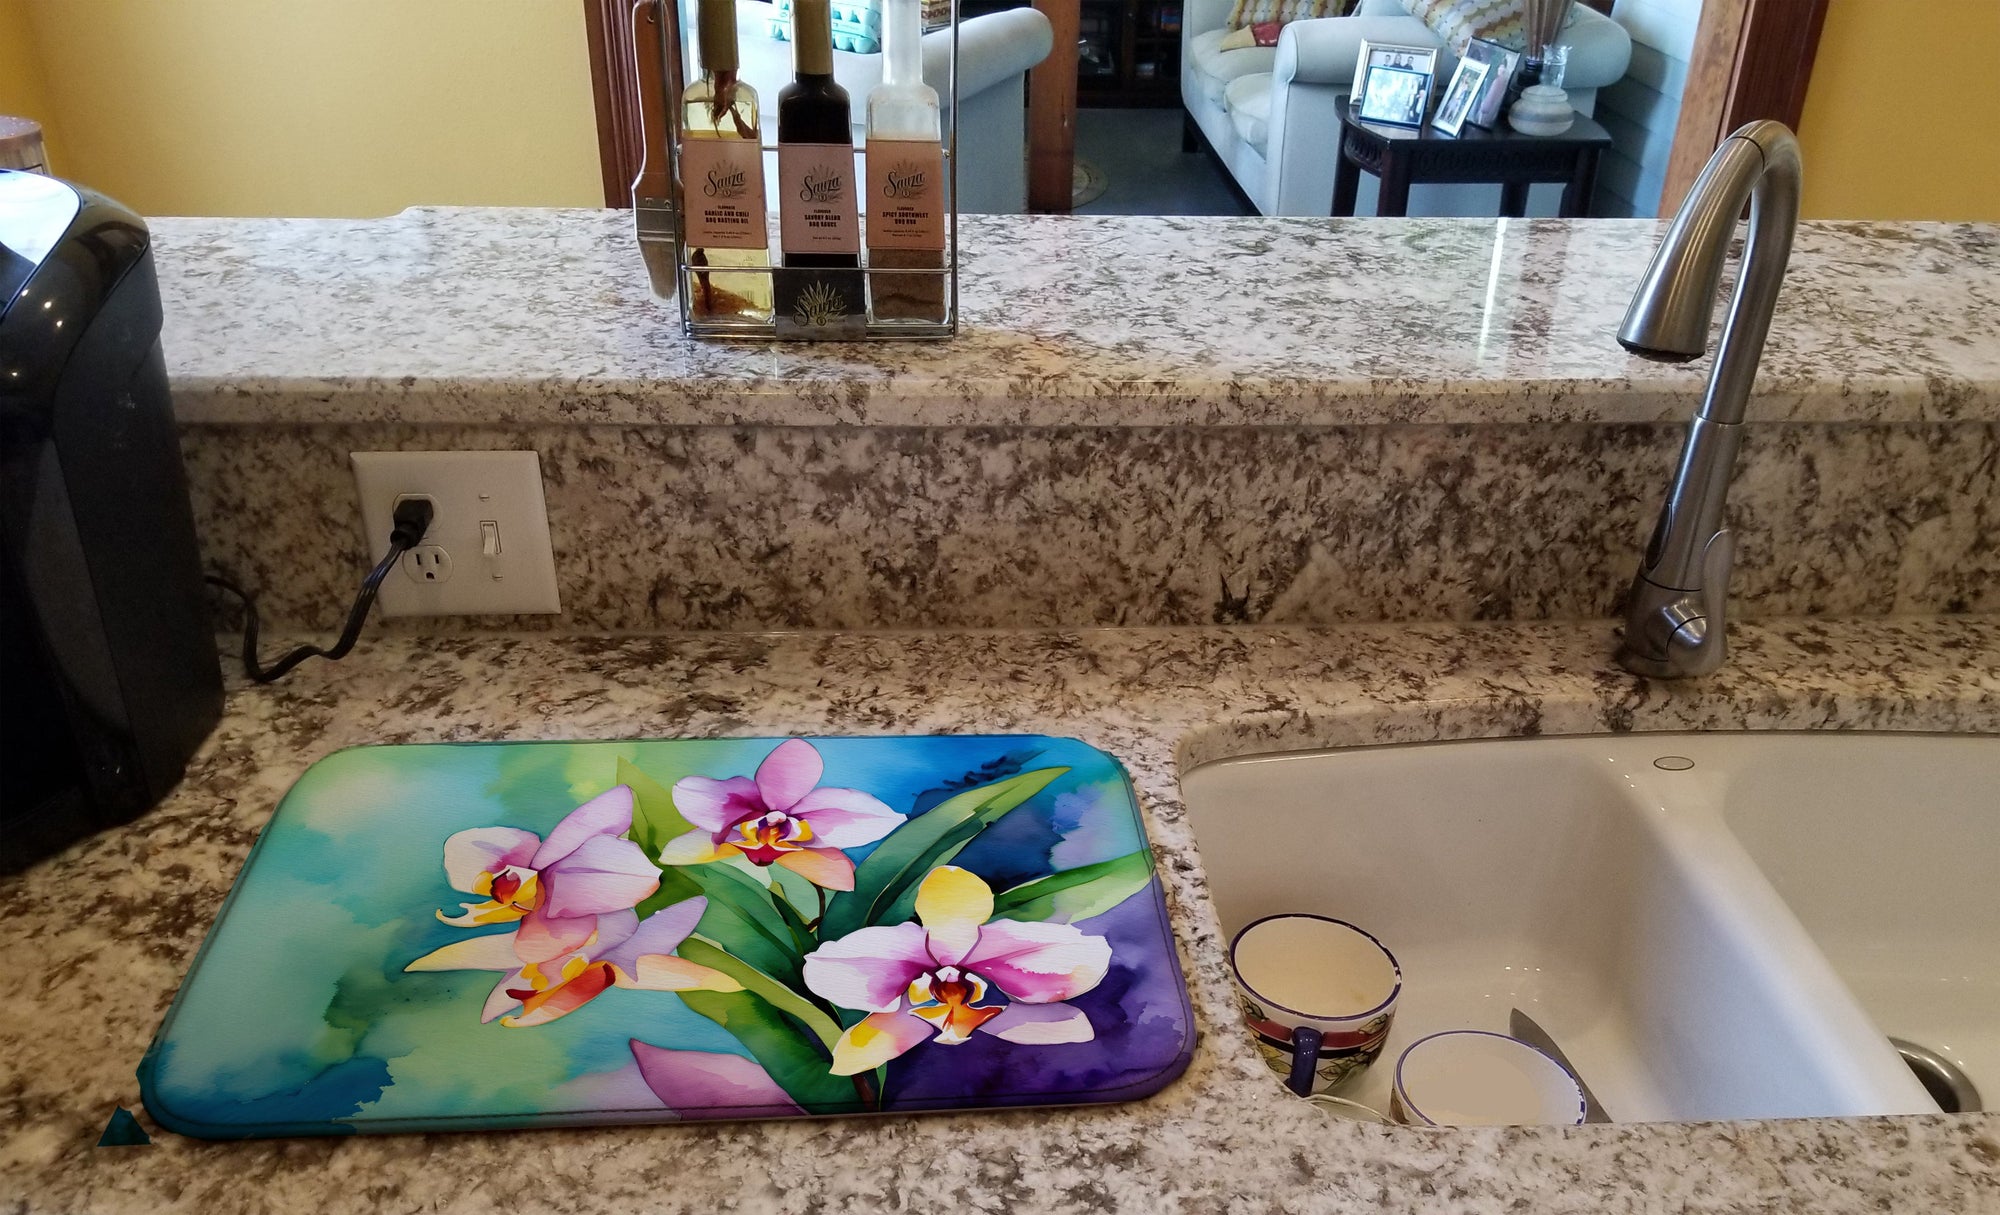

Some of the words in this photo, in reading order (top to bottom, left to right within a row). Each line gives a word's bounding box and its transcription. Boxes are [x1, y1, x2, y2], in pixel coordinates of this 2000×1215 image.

[703, 169, 747, 197] Sauza
[799, 175, 841, 202] Sauza
[883, 171, 925, 198] Sauza
[717, 217, 740, 225] BASTING
[898, 211, 929, 219] SOUTHWEST
[792, 294, 844, 327] Sauza
